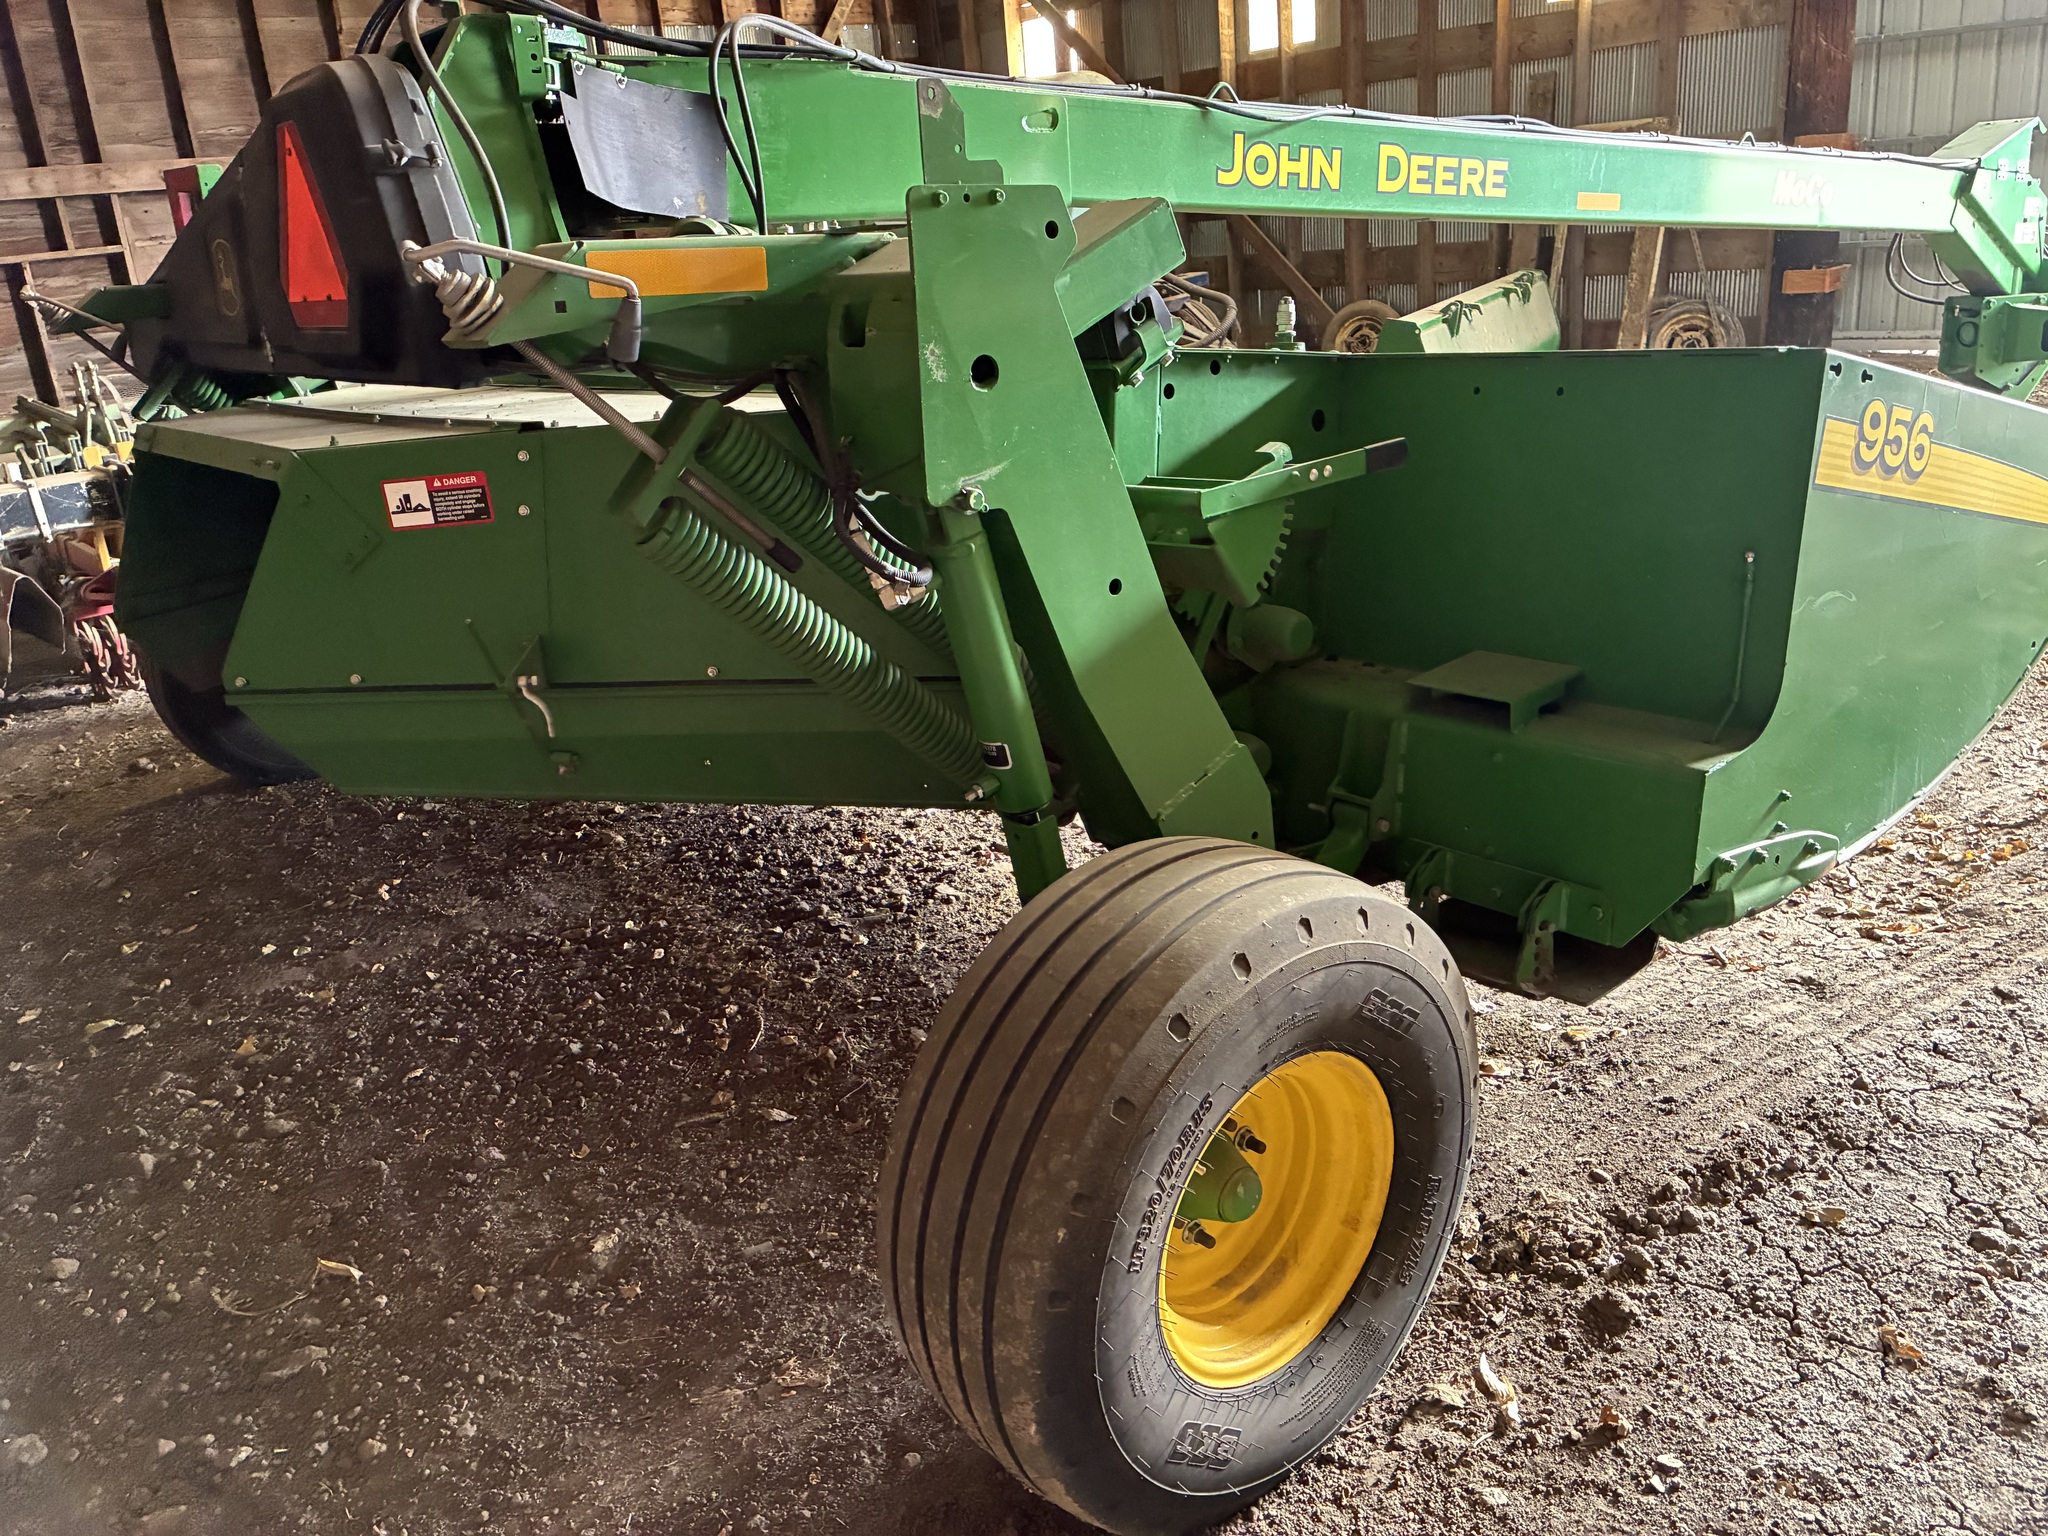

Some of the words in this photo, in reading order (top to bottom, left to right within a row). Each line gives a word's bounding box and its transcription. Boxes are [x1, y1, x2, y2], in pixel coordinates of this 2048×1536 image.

[1216, 130, 1343, 192] JOHN
[1376, 141, 1509, 198] DEERE
[1856, 398, 1934, 478] 956
[443, 476, 477, 486] DANGER
